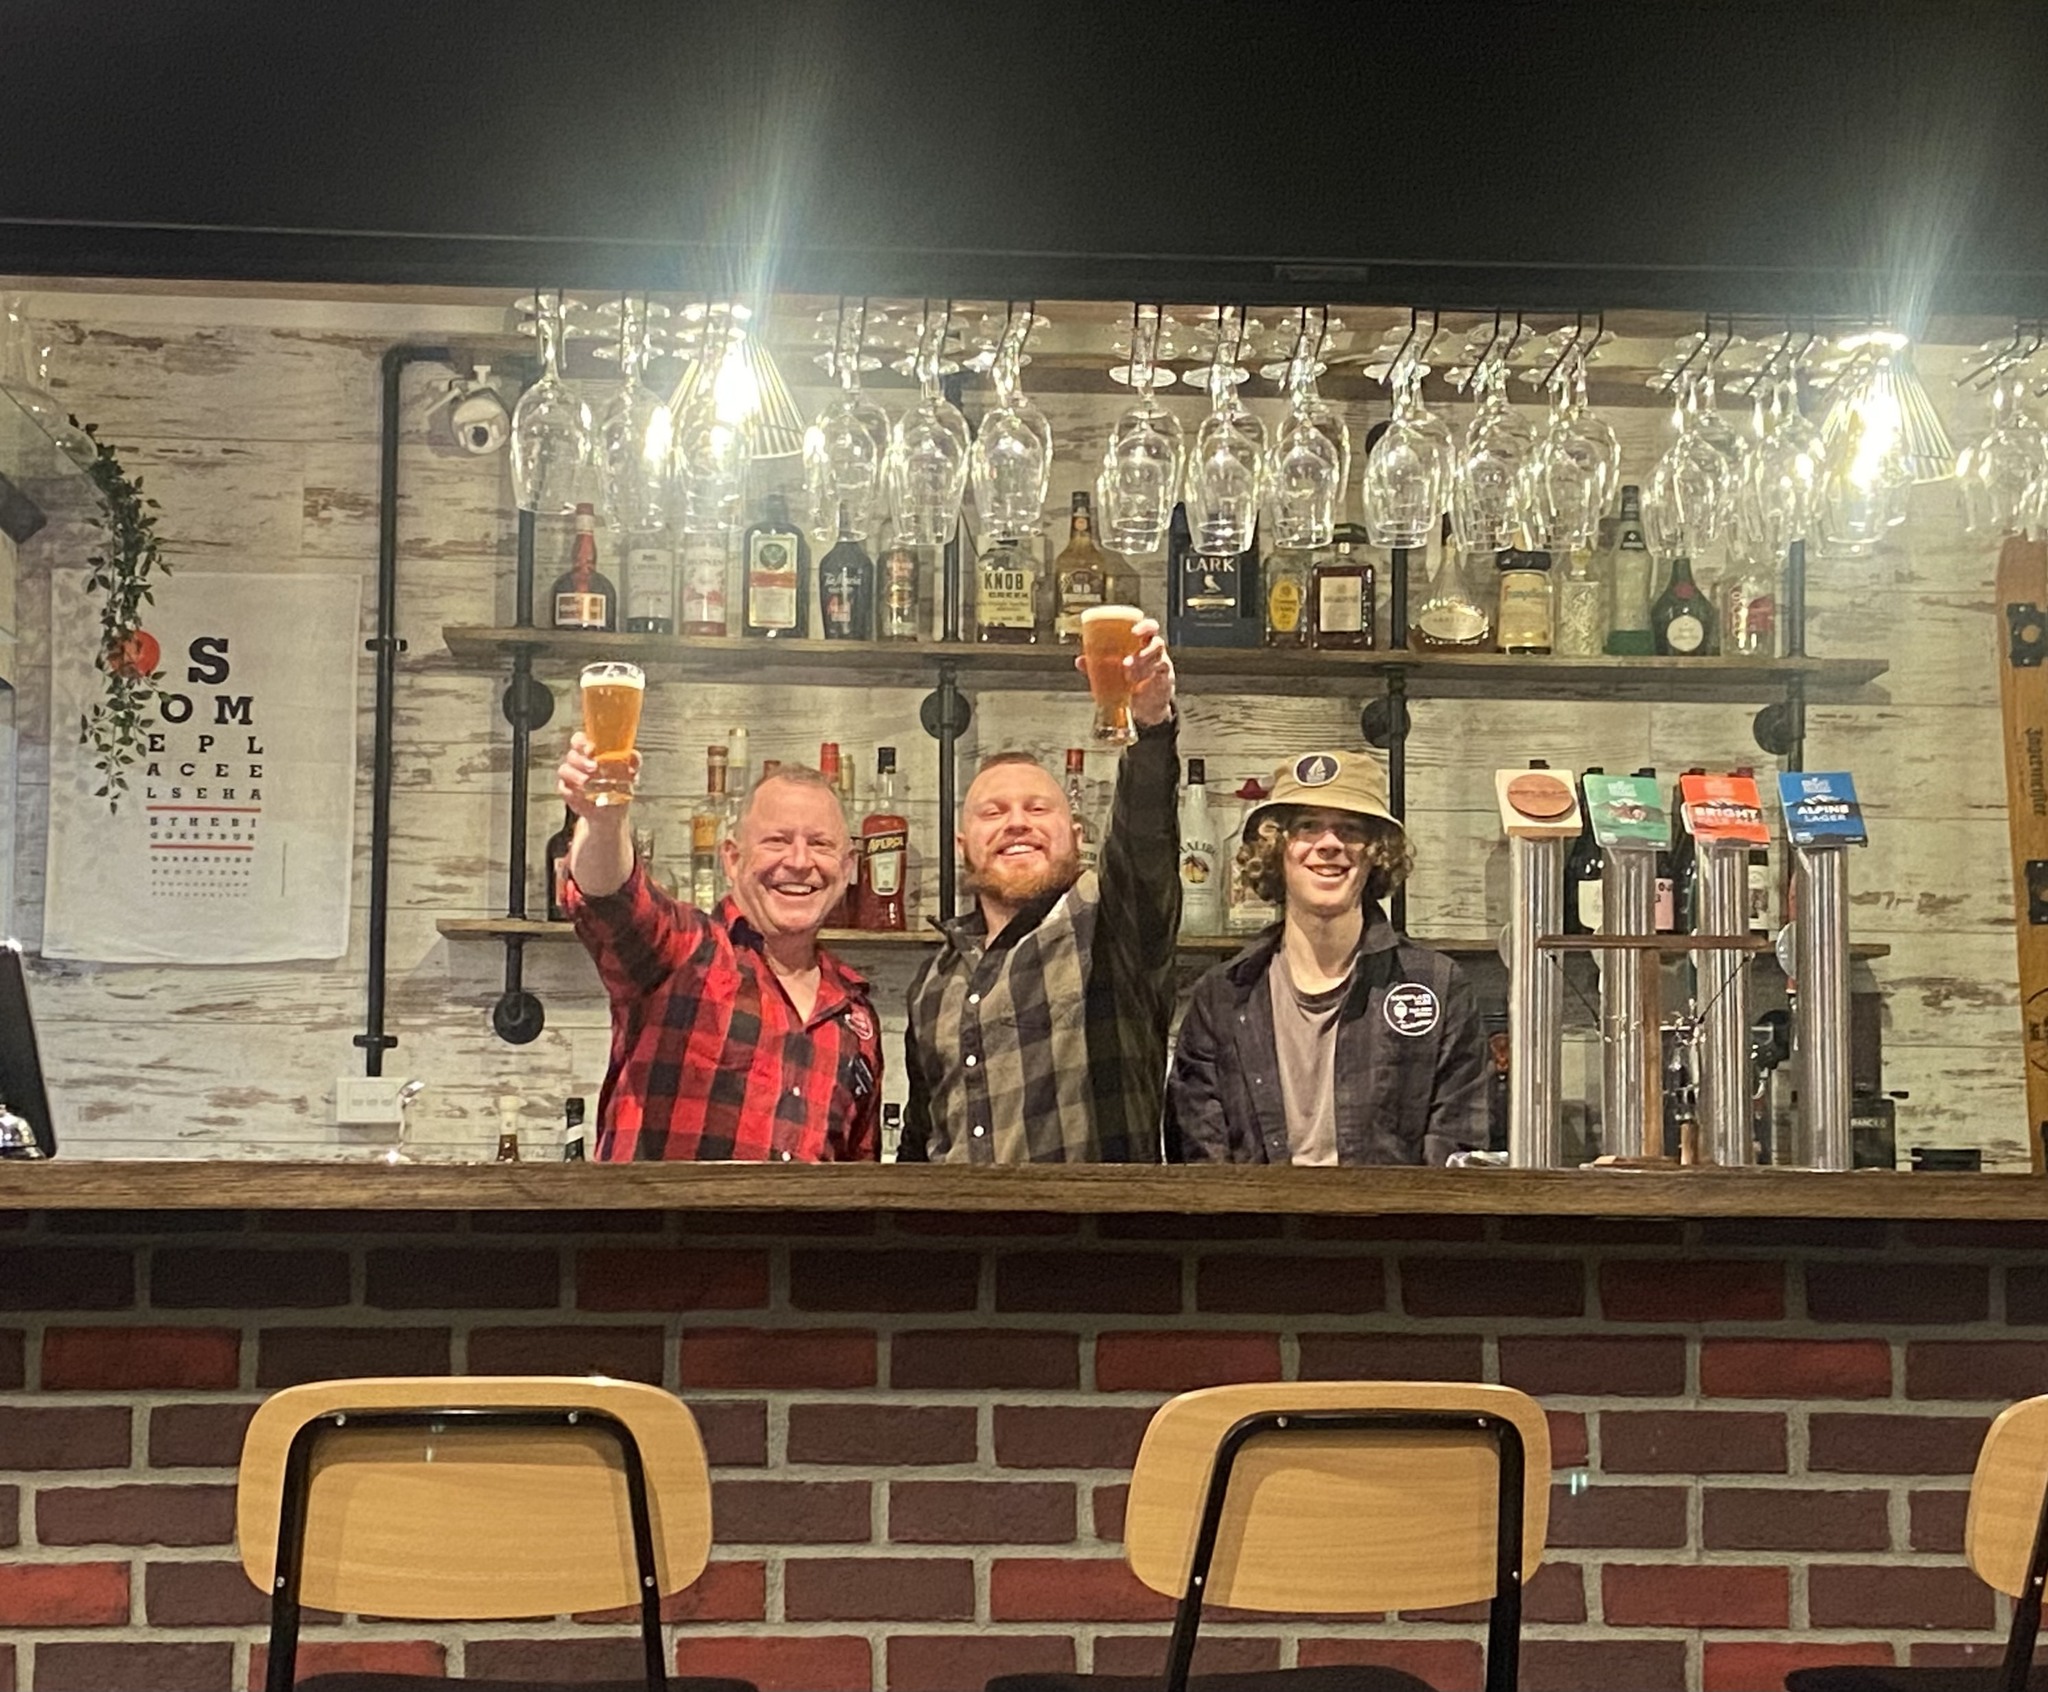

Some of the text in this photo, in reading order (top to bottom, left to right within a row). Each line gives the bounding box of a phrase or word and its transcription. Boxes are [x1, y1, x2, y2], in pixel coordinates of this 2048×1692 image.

[1185, 557, 1235, 573] LARK
[984, 573, 1024, 590] KNOB
[187, 636, 231, 685] S
[1695, 806, 1758, 820] BRIGHT
[1797, 804, 1850, 815] ALPINE
[1804, 814, 1847, 823] LAGER
